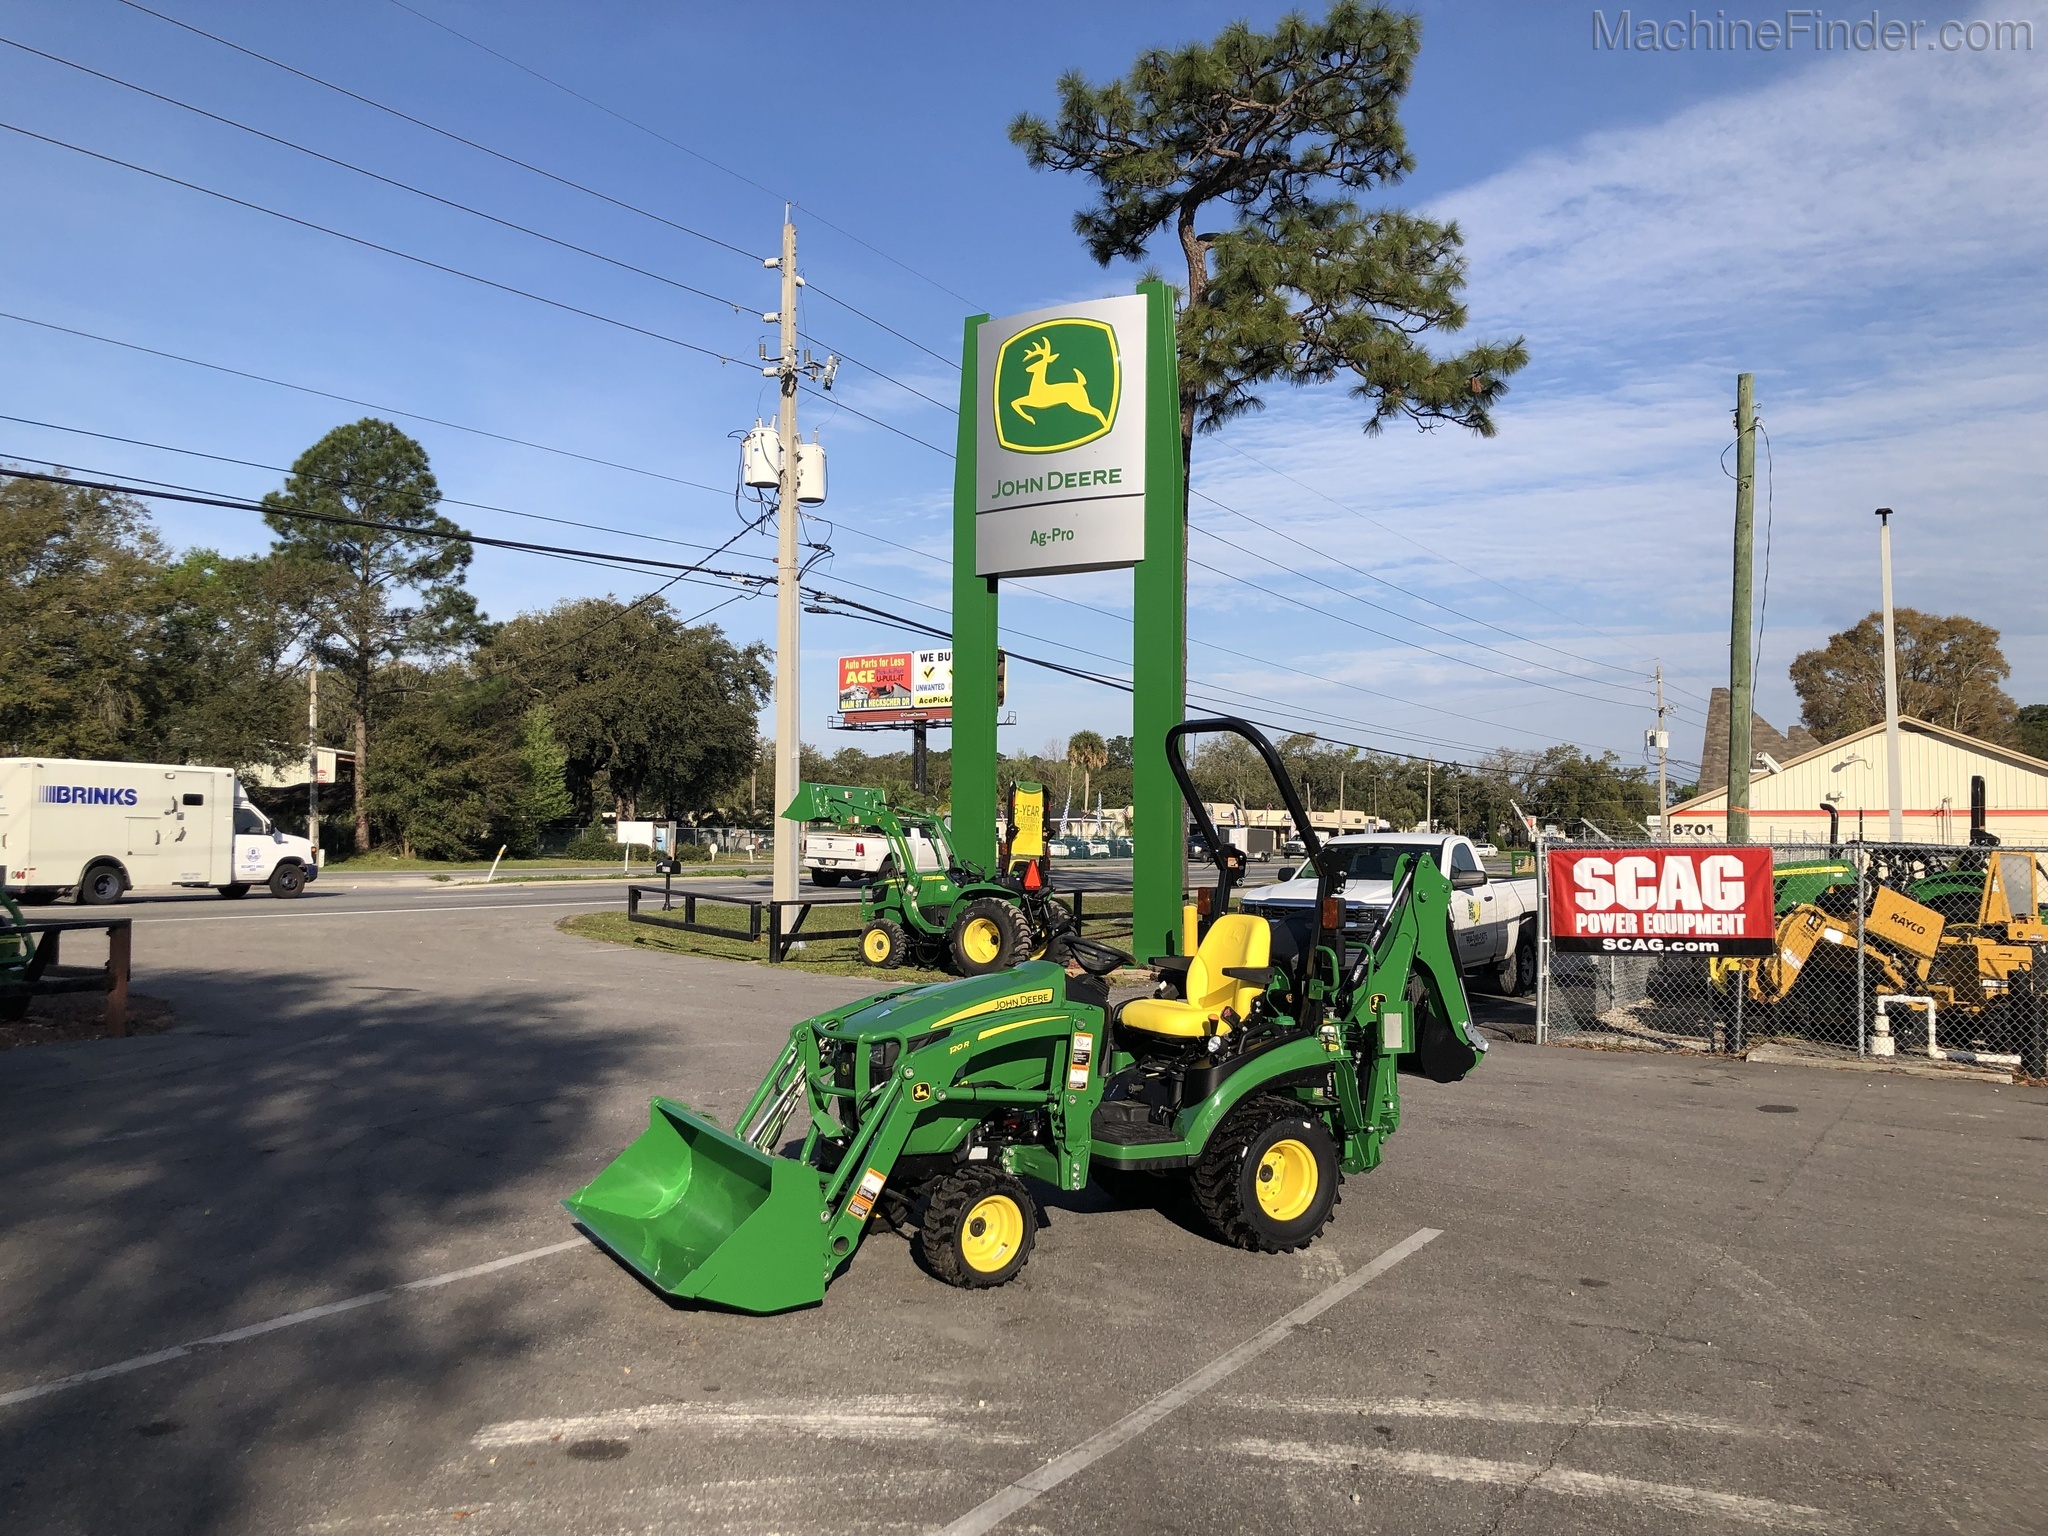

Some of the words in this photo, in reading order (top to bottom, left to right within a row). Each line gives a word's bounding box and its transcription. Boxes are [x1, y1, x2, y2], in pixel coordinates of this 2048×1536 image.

[991, 476, 1043, 499] JOHN
[1047, 468, 1122, 491] DEERE
[1030, 528, 1074, 546] Ag-Pro
[845, 660, 859, 670] Auto
[861, 659, 878, 669] Parts
[879, 658, 889, 667] for
[890, 657, 905, 667] Less
[920, 653, 934, 662] WE
[937, 652, 953, 662] BU
[845, 670, 876, 684] ACE
[876, 674, 904, 682] U-PULL-IT
[915, 683, 946, 692] UNWANTED
[841, 699, 855, 709] MAIN
[855, 699, 863, 708] ST
[56, 785, 138, 806] BRINKS
[1673, 824, 1713, 835] 8701
[1573, 855, 1745, 911] SCAG
[1575, 913, 1638, 934] POWER
[1643, 913, 1746, 935] EQUIPMENT
[1890, 913, 1925, 935] RAYCO
[1602, 938, 1719, 952] SCAG.com
[994, 999, 1019, 1010] JOHN
[1020, 994, 1049, 1005] DEERE
